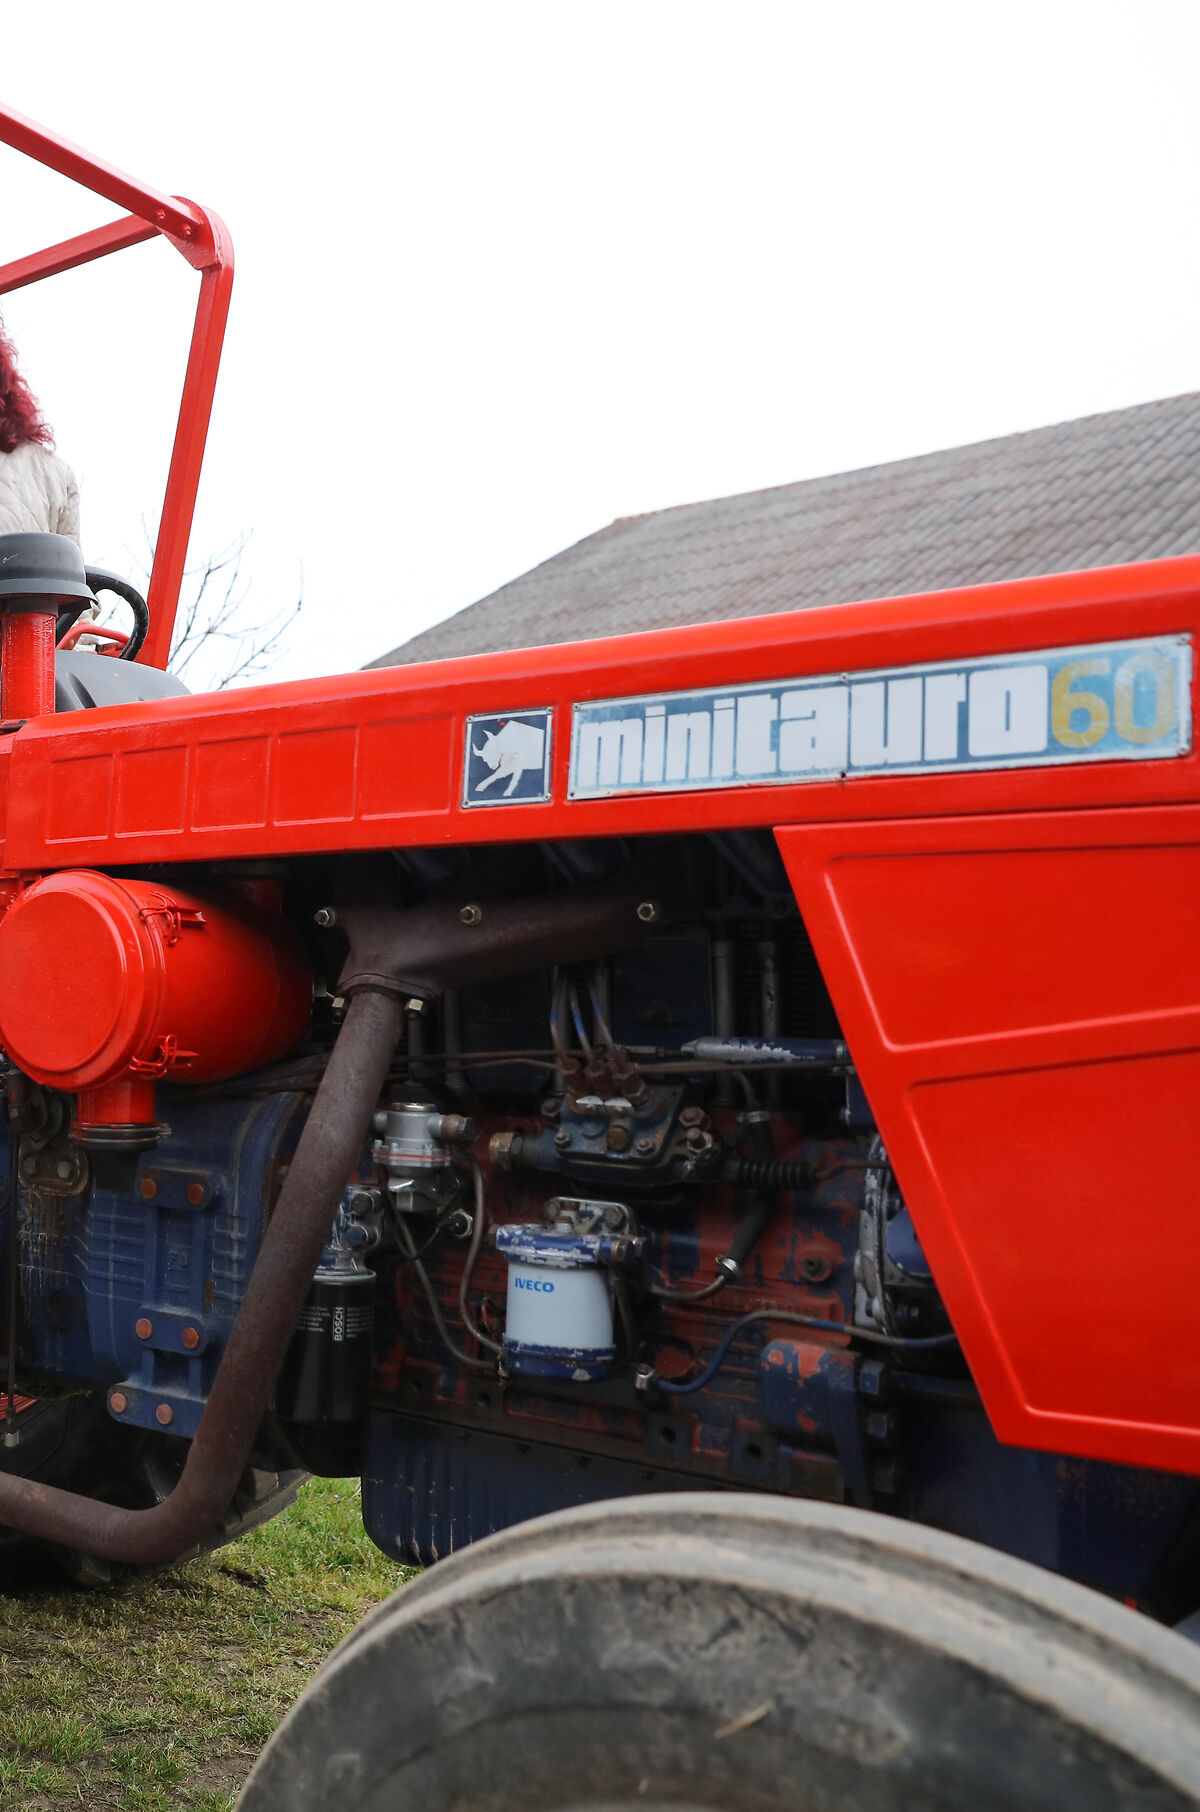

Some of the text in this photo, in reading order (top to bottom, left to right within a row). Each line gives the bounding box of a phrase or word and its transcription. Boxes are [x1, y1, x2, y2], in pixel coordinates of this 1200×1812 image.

[578, 655, 1176, 788] minitauro 60
[514, 1277, 555, 1293] IVECO
[334, 1307, 344, 1341] BOSCH
